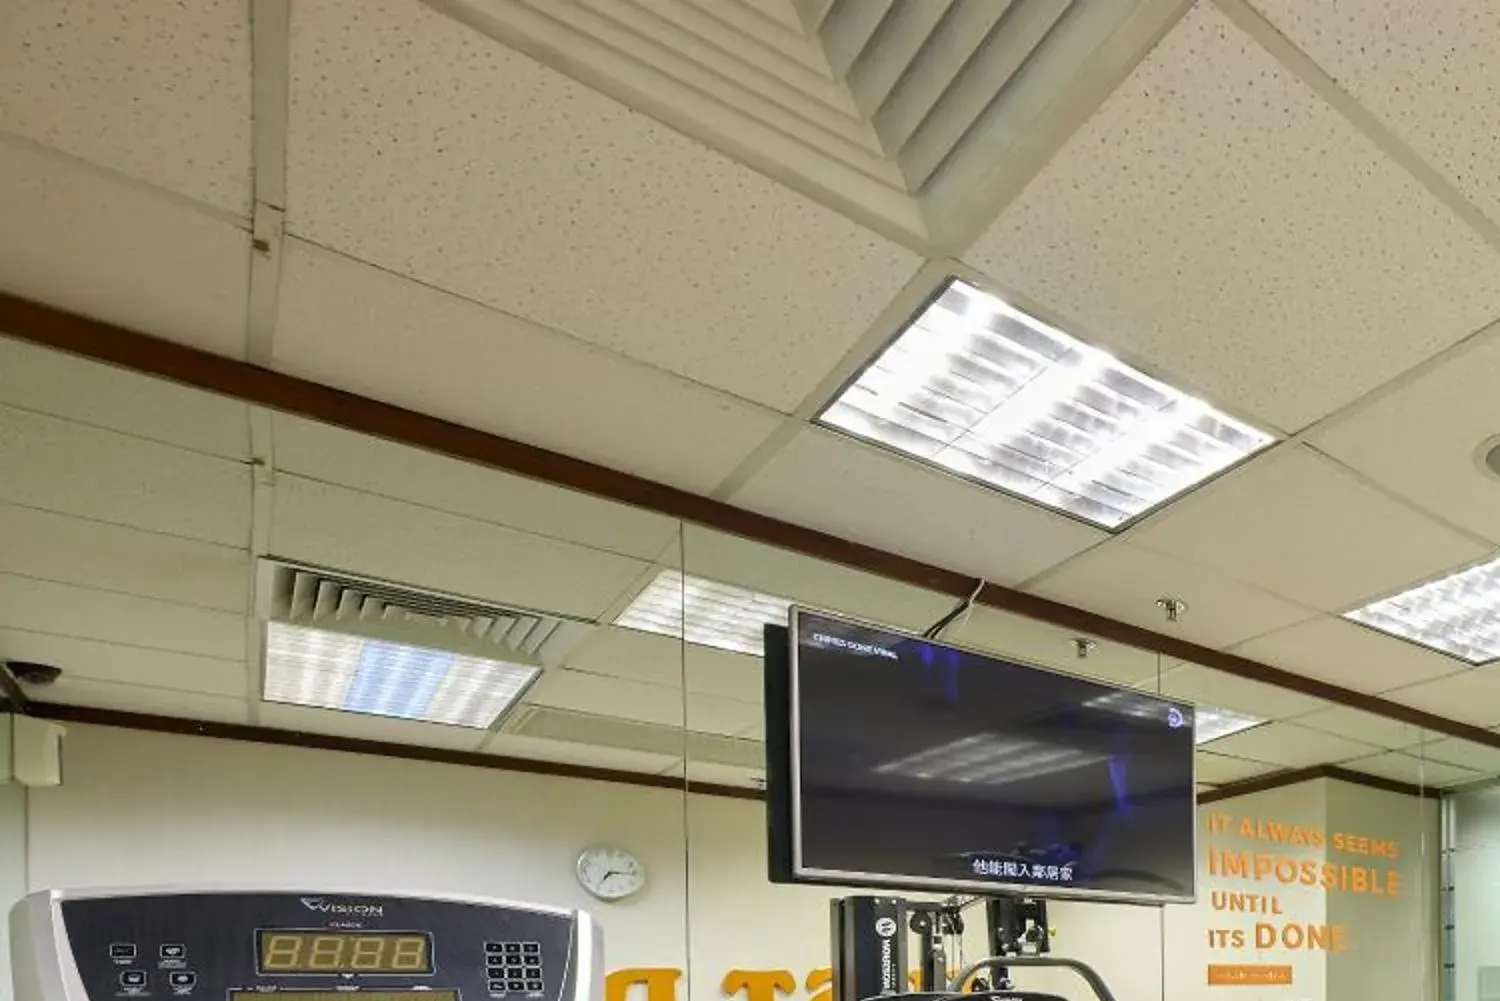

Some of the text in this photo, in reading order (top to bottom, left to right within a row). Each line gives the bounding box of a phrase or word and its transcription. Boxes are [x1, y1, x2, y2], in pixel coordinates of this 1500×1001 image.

[1209, 813, 1398, 858] IT ALWAYS SEEMS
[1209, 846, 1400, 895] IMPOSSIBLE
[1211, 891, 1282, 914] UNTIL
[1209, 923, 1349, 953] ITS DONE
